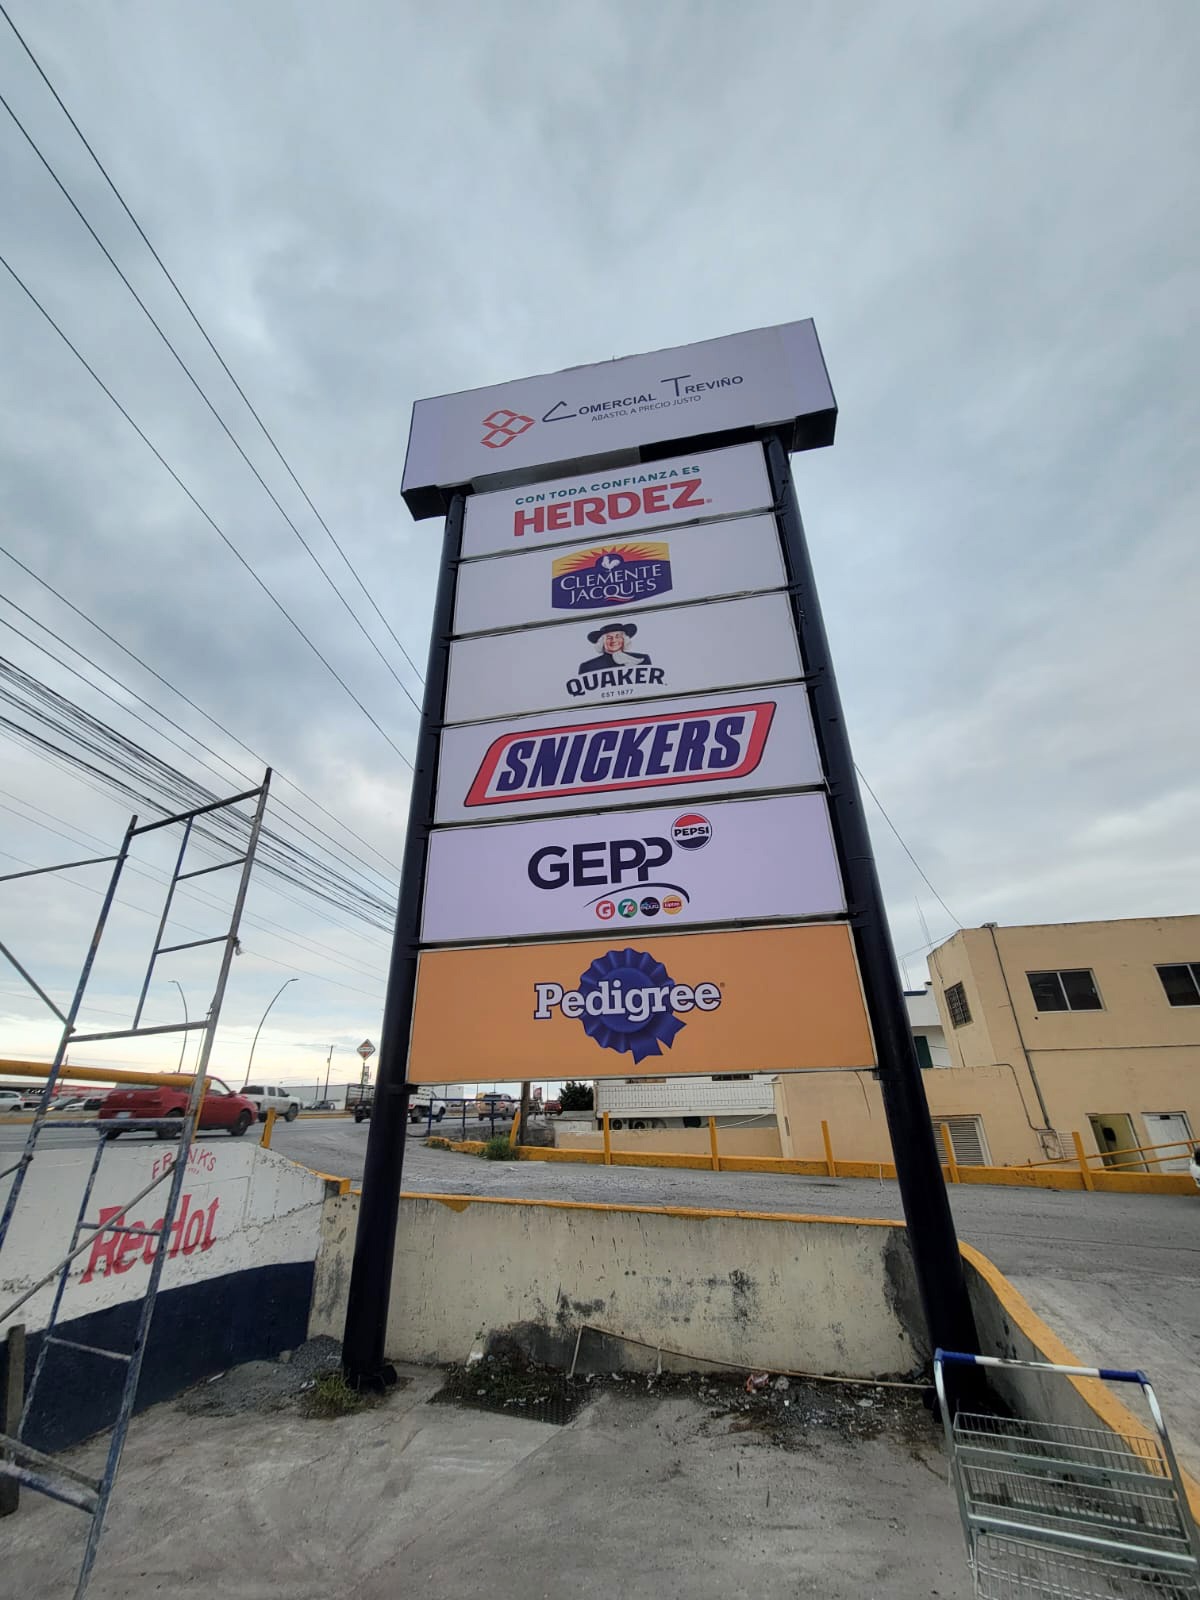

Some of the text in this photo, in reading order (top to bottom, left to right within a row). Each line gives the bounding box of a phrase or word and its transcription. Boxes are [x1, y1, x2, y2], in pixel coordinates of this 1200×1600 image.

[542, 375, 744, 422] COMERCIAL TREVIÑO
[630, 407, 638, 415] A
[639, 401, 671, 413] PRECIO
[673, 395, 702, 406] JUSTO
[515, 465, 700, 505] CON TODA CONFIANZA ES
[514, 478, 705, 537] HERDEZ
[560, 564, 662, 590] CLEMENTE
[569, 578, 657, 605] JACQUES
[566, 667, 665, 697] QUAKER
[496, 716, 746, 791] SNICKERS
[674, 826, 710, 837] PEPSI
[528, 837, 673, 890] GEPP
[534, 980, 721, 1022] Pedigree
[152, 1148, 217, 1180] FRNK'S
